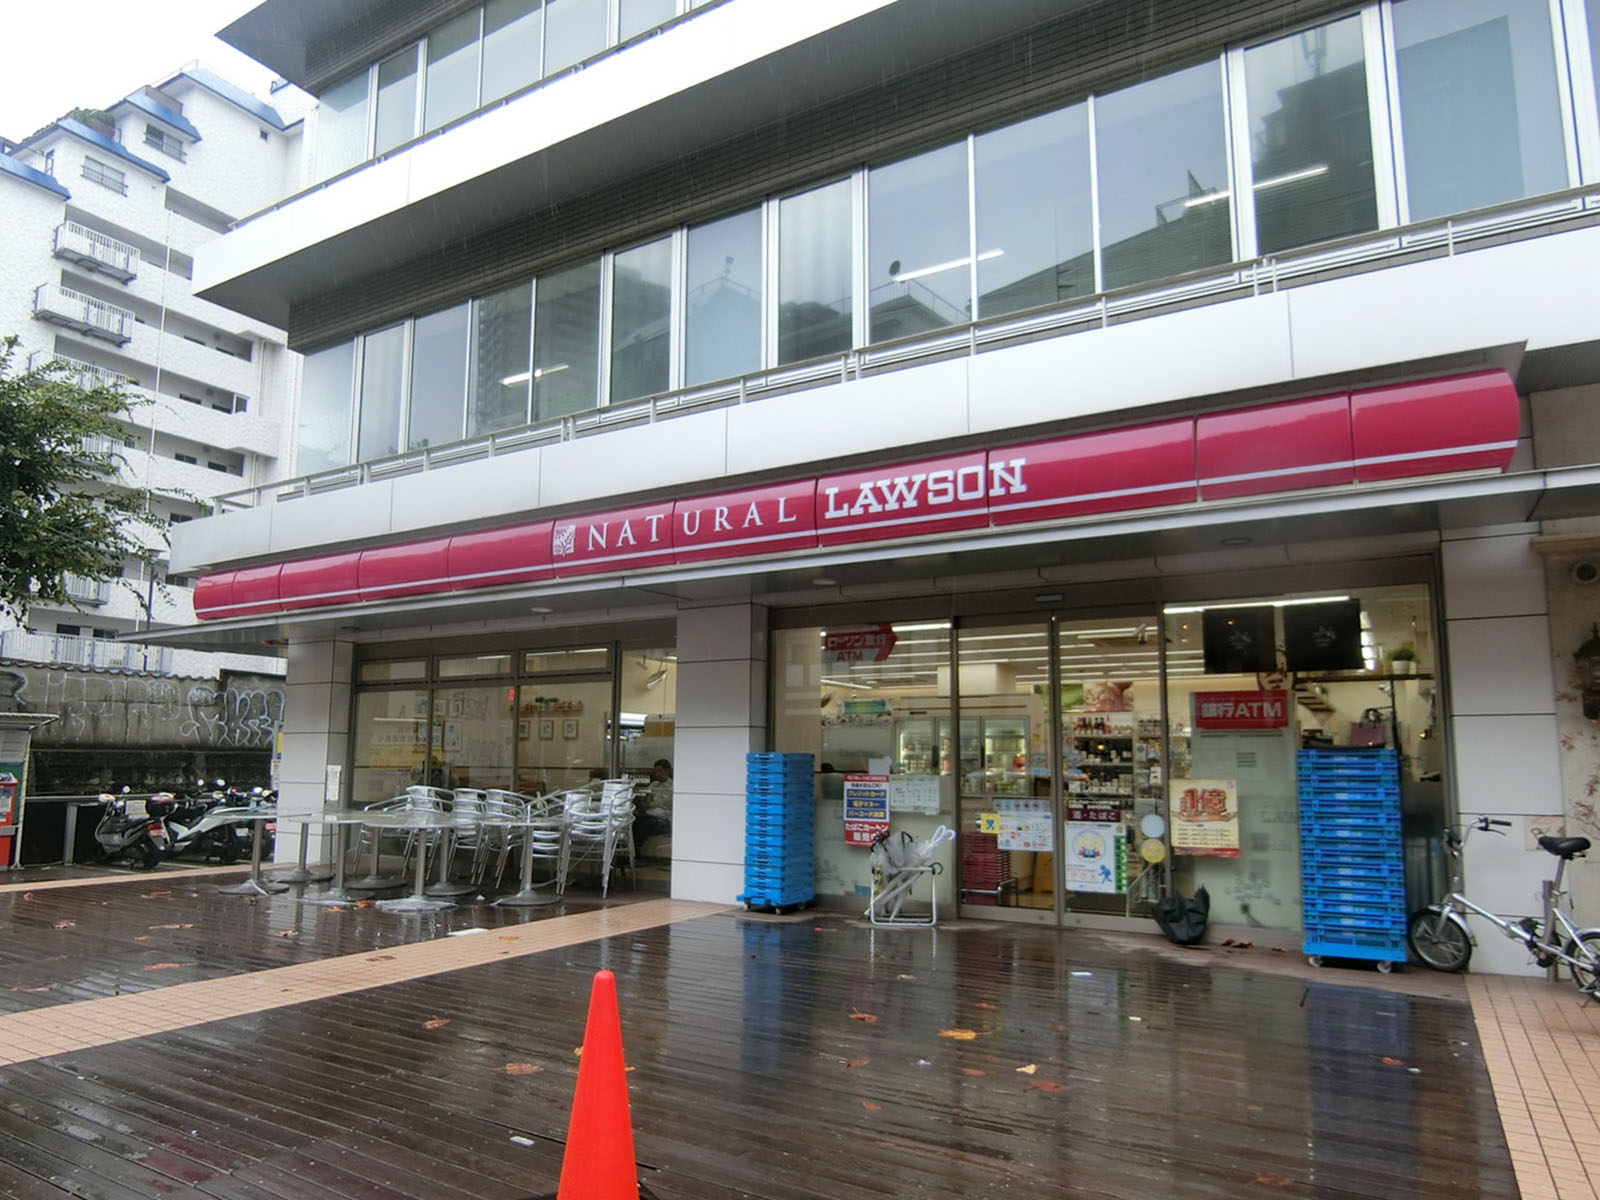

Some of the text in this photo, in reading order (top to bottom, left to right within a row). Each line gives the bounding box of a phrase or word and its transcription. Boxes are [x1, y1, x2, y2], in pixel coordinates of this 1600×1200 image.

[587, 458, 1027, 551] NATURAL LAWSON
[836, 650, 863, 661] ATM
